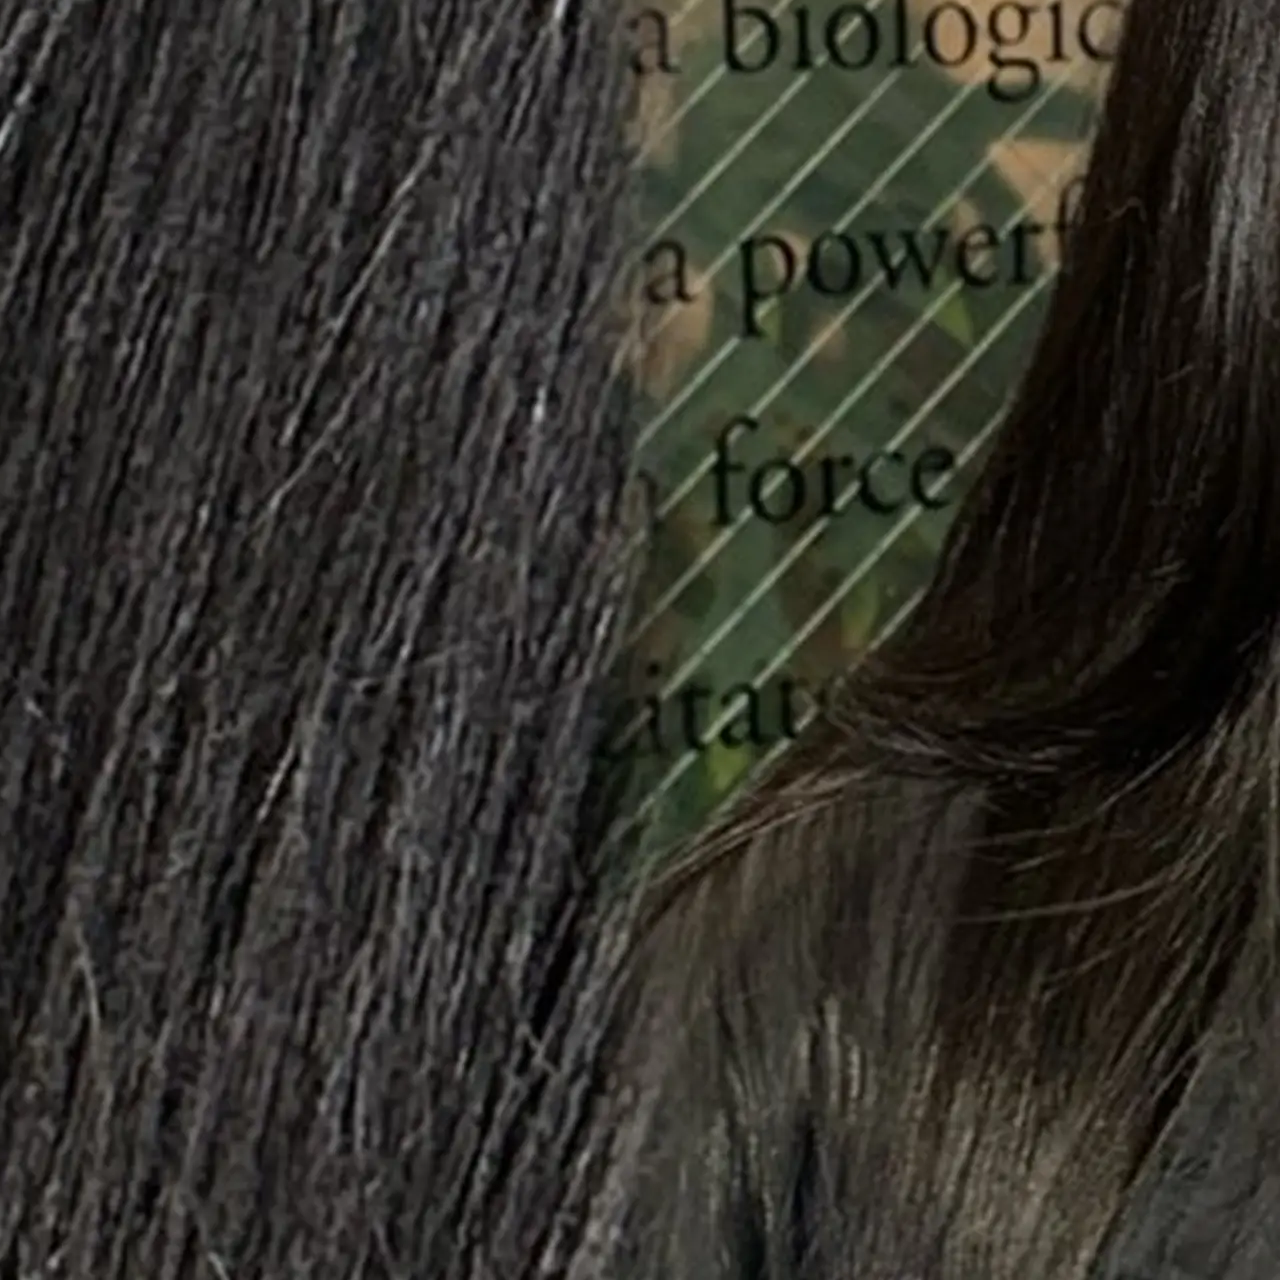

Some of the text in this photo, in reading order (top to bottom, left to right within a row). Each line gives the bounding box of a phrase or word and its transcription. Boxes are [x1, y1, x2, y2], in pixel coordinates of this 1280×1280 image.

[627, 4, 680, 76] a
[642, 236, 696, 306] a
[711, 415, 956, 527] force
